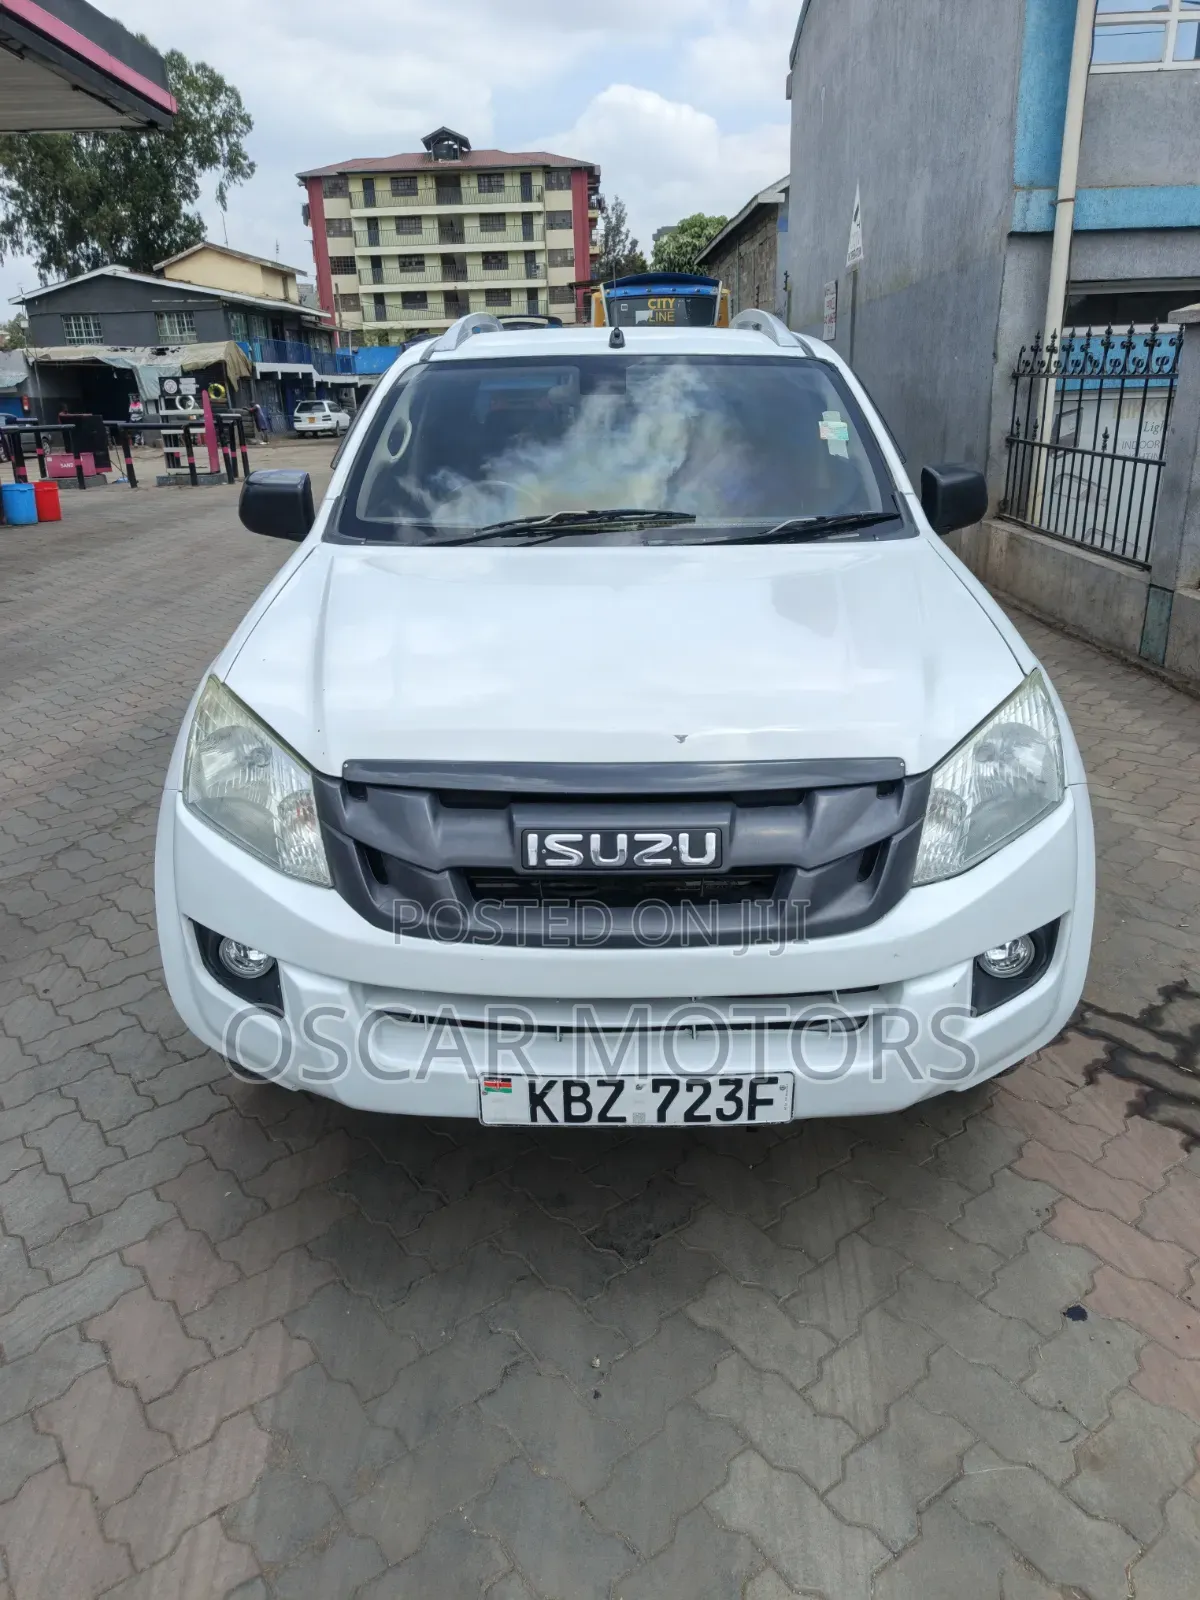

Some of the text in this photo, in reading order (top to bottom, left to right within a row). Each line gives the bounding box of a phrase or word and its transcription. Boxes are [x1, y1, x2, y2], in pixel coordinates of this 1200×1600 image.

[647, 298, 676, 310] CITY
[648, 311, 676, 322] LINE
[527, 832, 717, 867] ISUZU
[528, 1078, 628, 1123] KBZ
[651, 1076, 779, 1123] 723F
